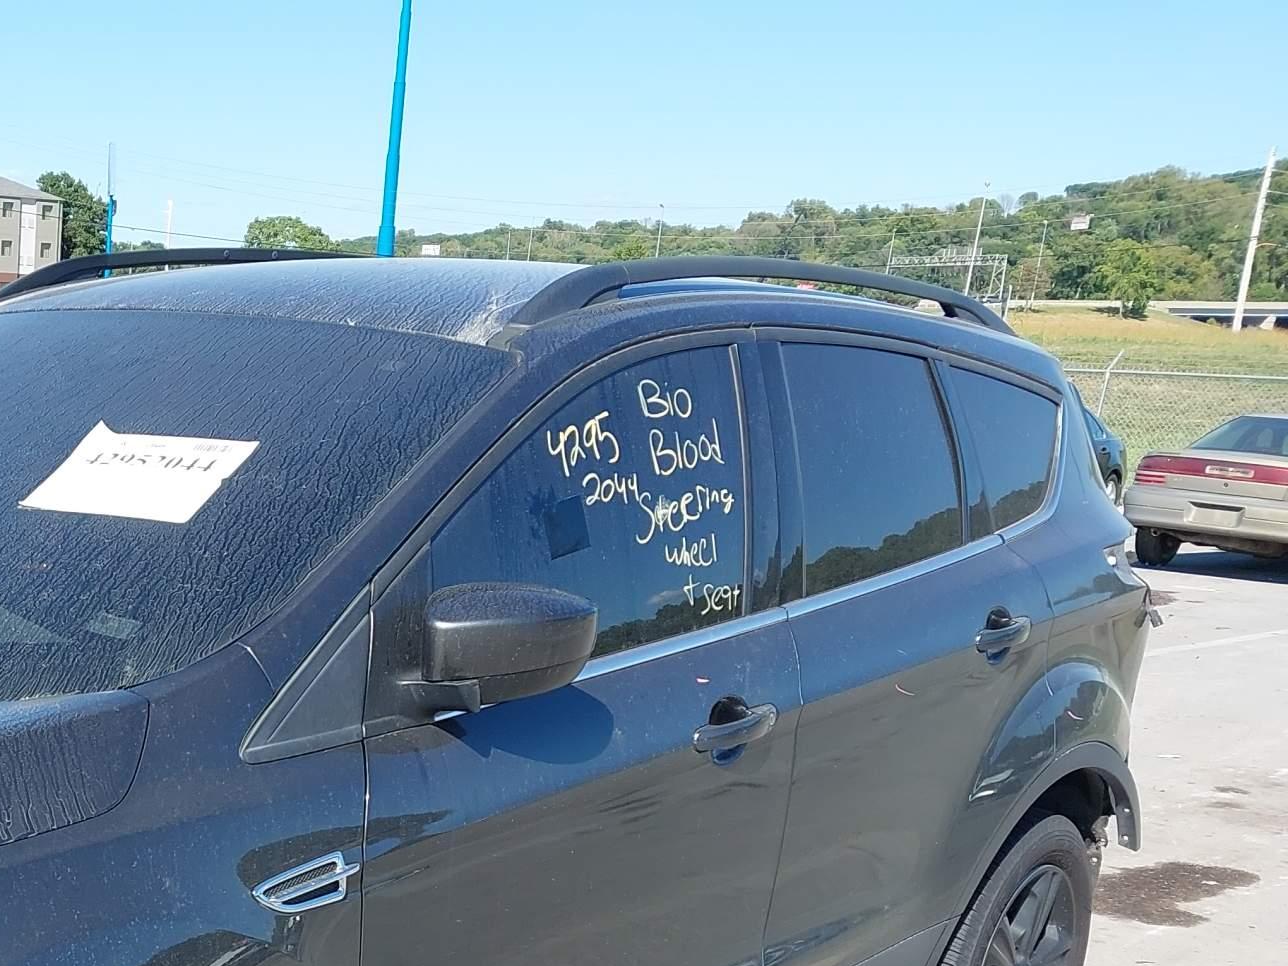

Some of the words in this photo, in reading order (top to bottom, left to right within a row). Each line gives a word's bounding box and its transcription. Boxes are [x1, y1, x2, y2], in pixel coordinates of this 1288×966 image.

[546, 411, 621, 477] 4295
[649, 418, 725, 476] Blood
[582, 473, 641, 505] 2044
